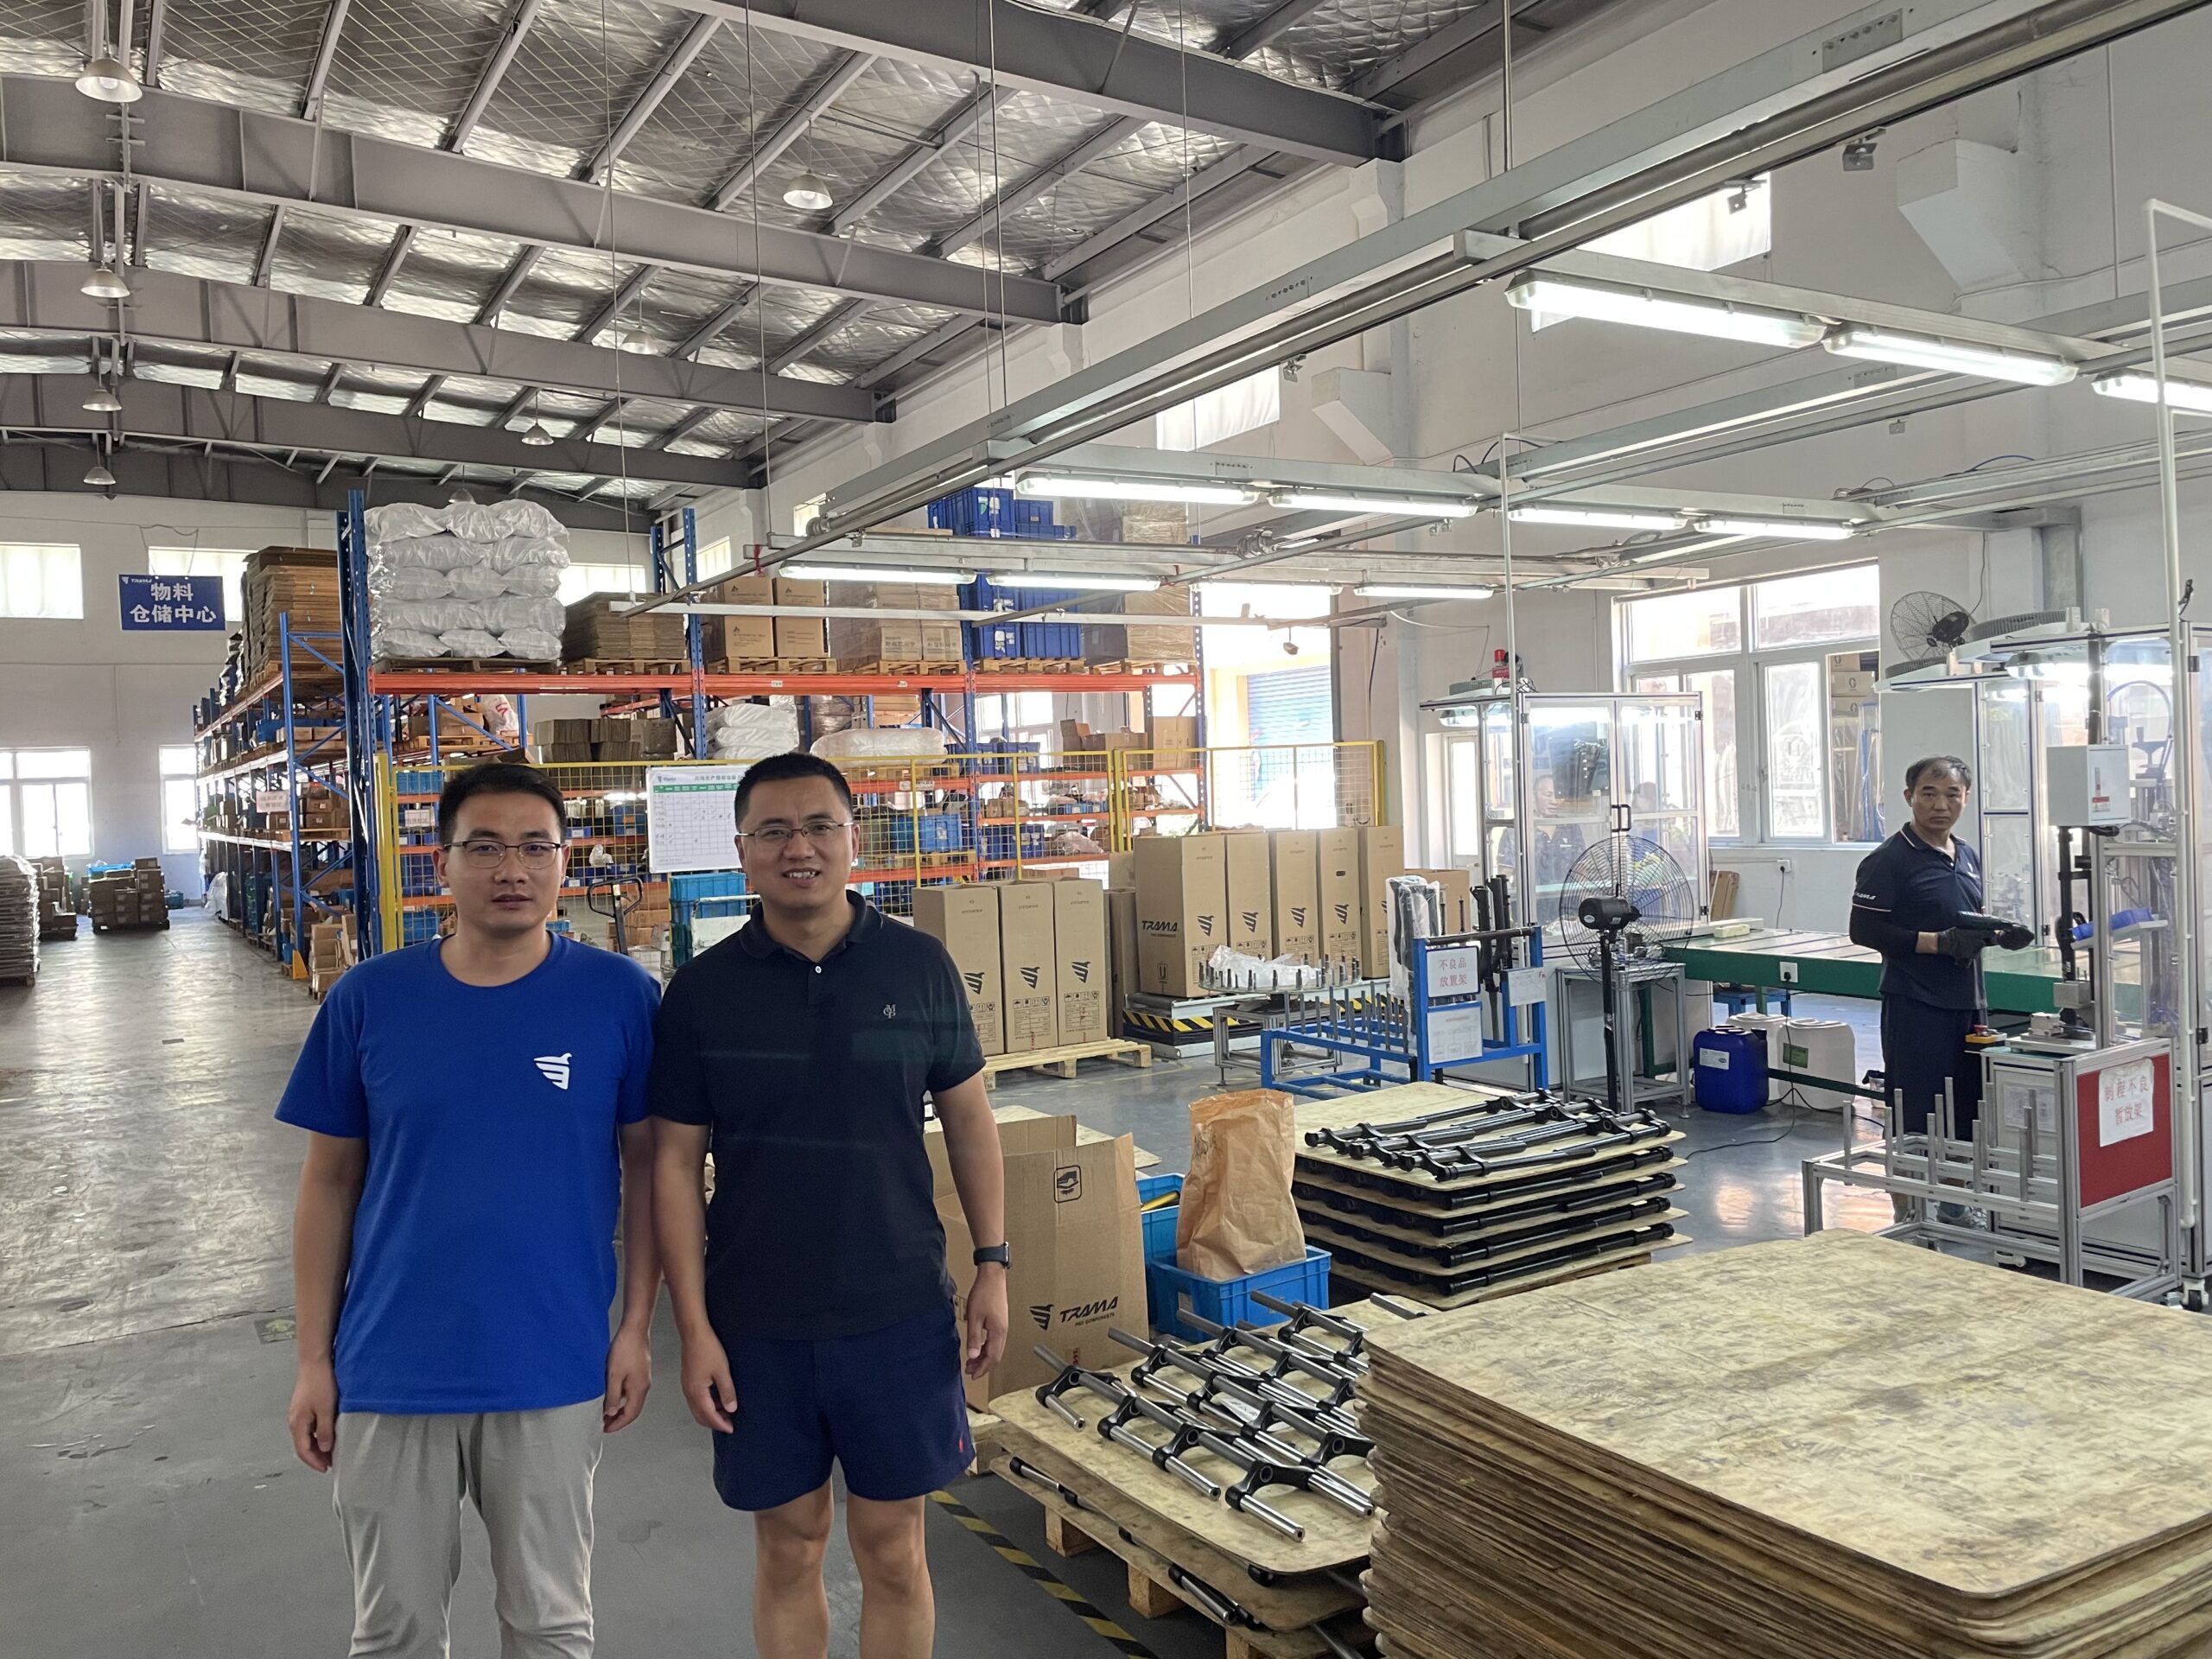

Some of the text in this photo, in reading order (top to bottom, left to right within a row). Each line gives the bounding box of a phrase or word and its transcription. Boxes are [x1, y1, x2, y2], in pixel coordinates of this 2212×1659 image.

[150, 582, 194, 601] 物料
[130, 604, 217, 623] 仓储中心
[1141, 919, 1179, 932] TRAMA
[1438, 957, 1467, 971] 不良品
[1439, 974, 1468, 988] 放置架
[1059, 1296, 1118, 1323] TRAMA
